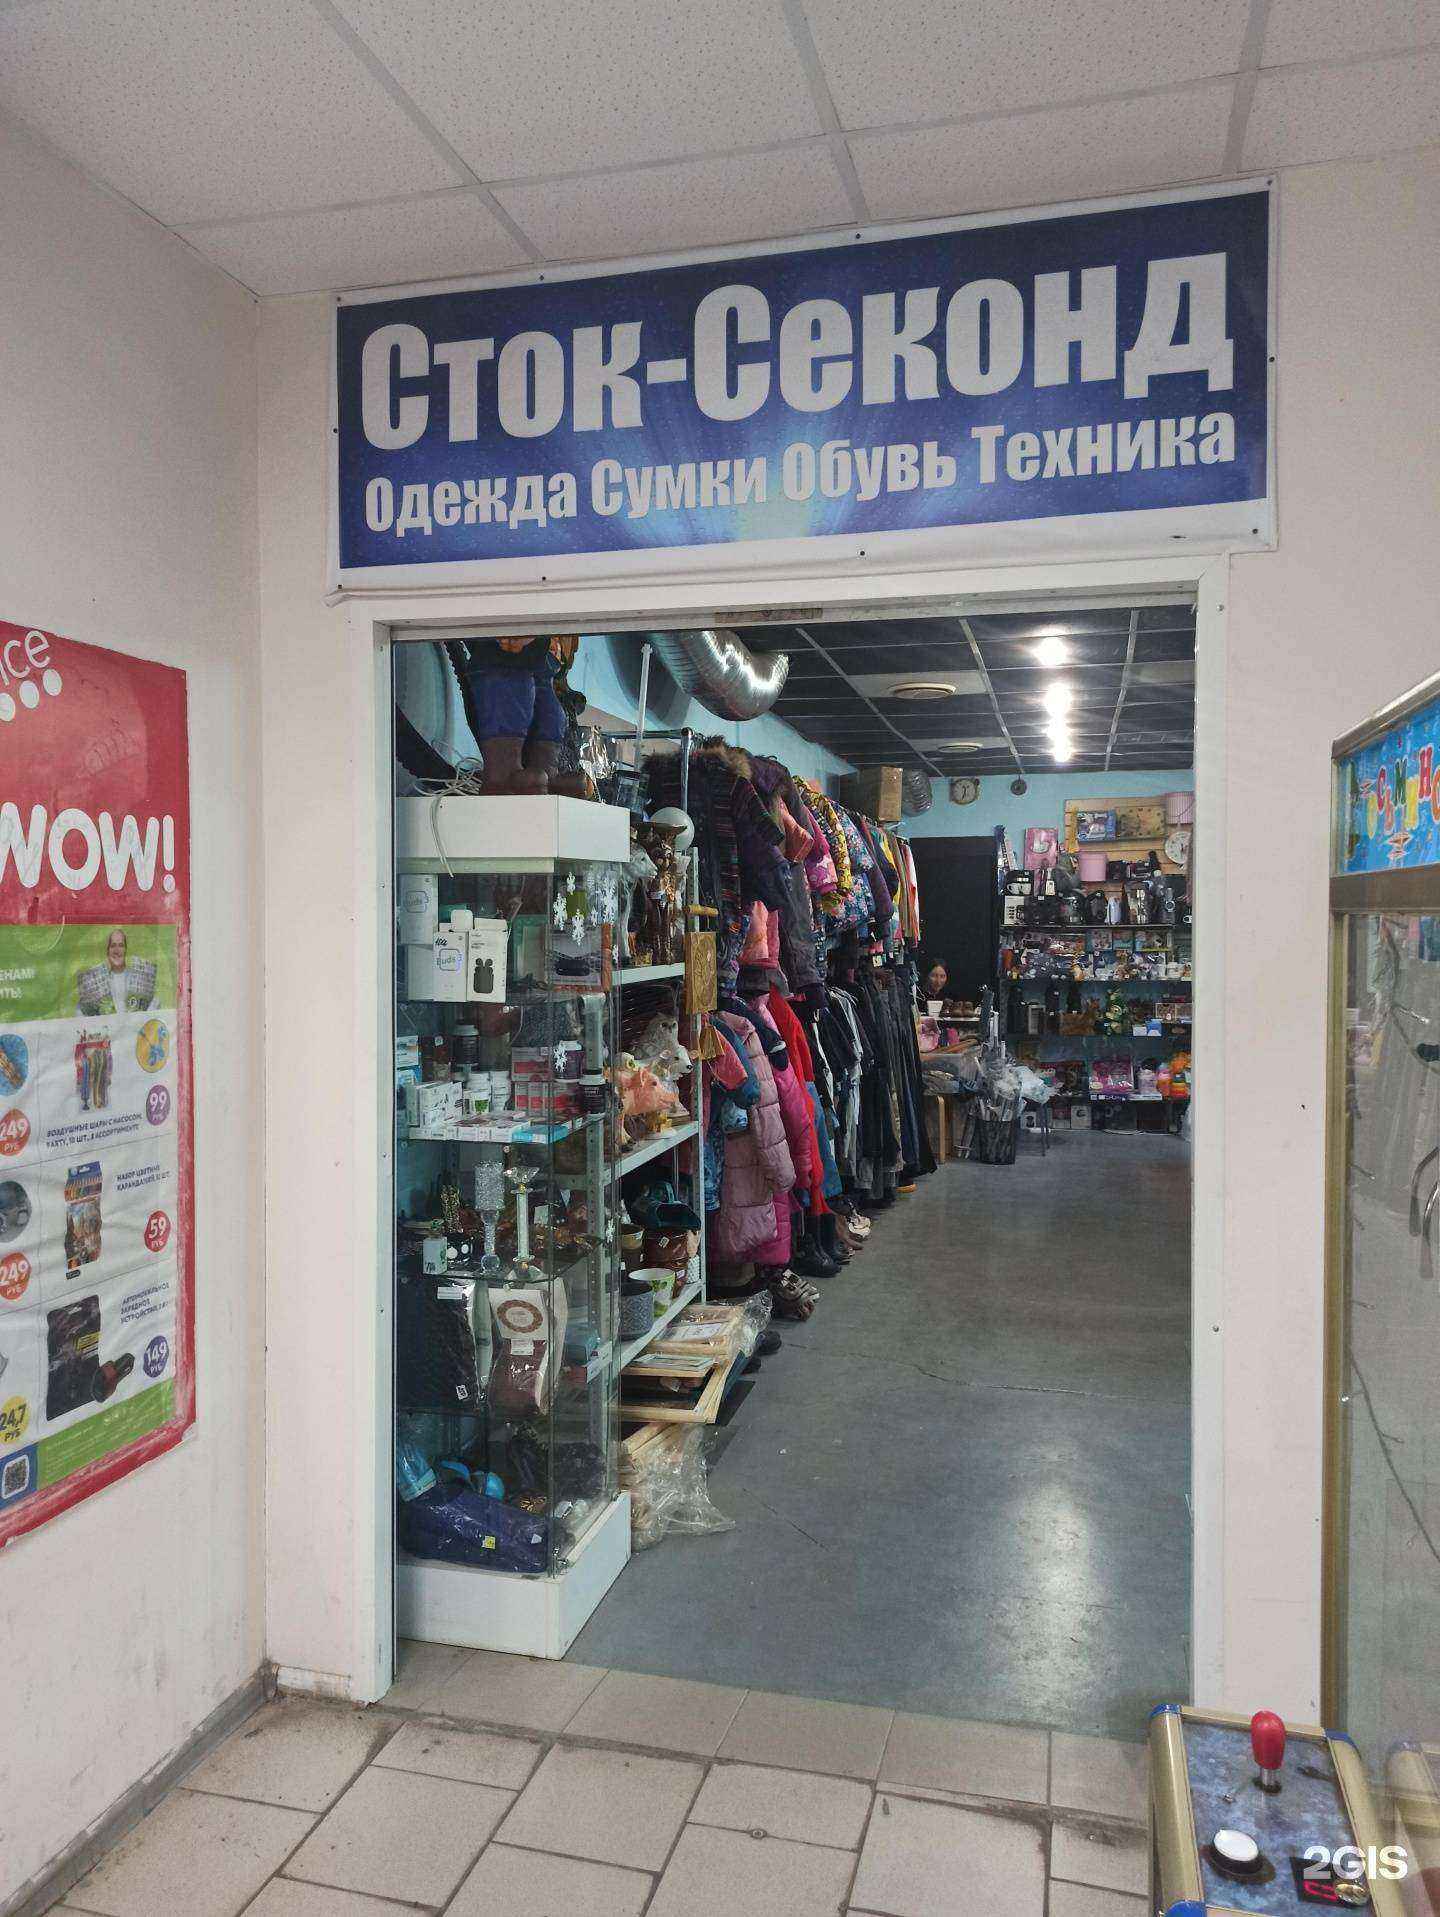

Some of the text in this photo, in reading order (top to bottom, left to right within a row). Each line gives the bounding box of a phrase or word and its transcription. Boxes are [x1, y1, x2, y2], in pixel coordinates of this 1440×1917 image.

[361, 251, 1236, 451] Сток-Секонд
[365, 411, 1236, 538] Одежда Сумки Обувь Техника
[0, 801, 176, 893] WOW!
[149, 1091, 168, 1112] 99
[0, 1118, 29, 1140] 249
[148, 1216, 167, 1239] 59
[0, 1259, 29, 1286] 249
[145, 1341, 168, 1366] 149
